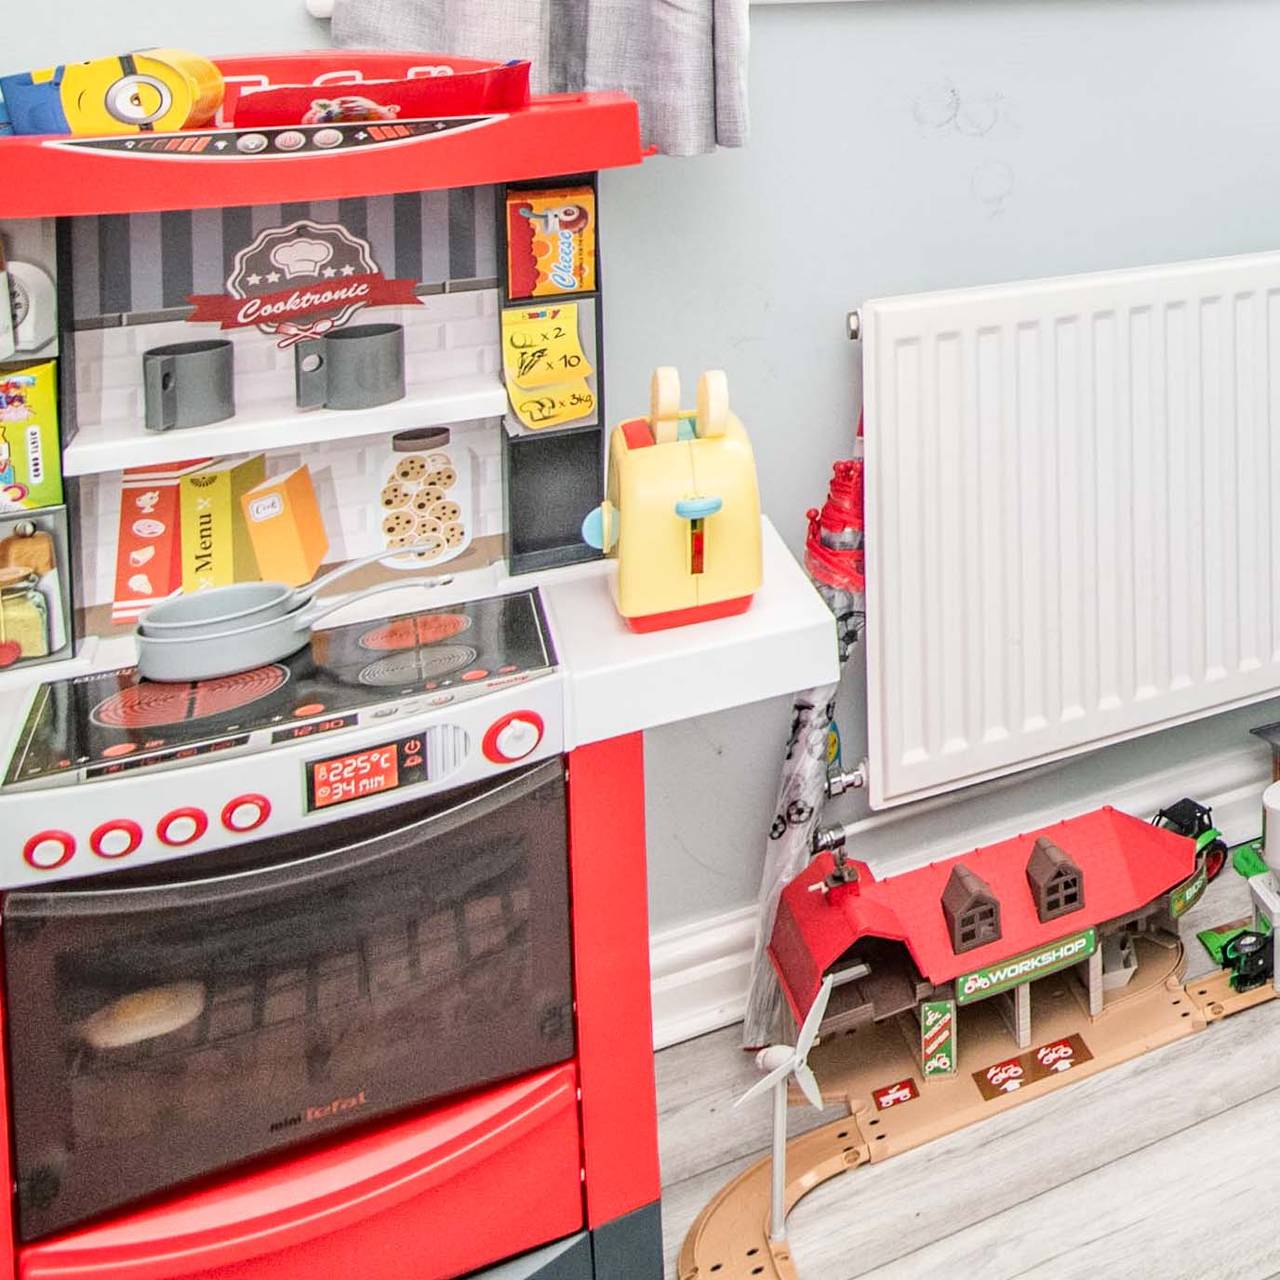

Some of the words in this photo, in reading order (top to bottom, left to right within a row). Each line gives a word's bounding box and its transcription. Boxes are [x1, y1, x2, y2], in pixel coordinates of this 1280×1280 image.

[551, 230, 577, 289] Cheese
[237, 282, 370, 323] Cooktronic
[553, 327, 566, 339] 2
[558, 357, 581, 369] 10
[568, 394, 593, 412] 3kg
[194, 512, 213, 575] Menu
[293, 719, 345, 737] 12:30
[329, 752, 391, 781] 225°C
[332, 781, 355, 800] 34
[988, 937, 1087, 984] WORKSHOP
